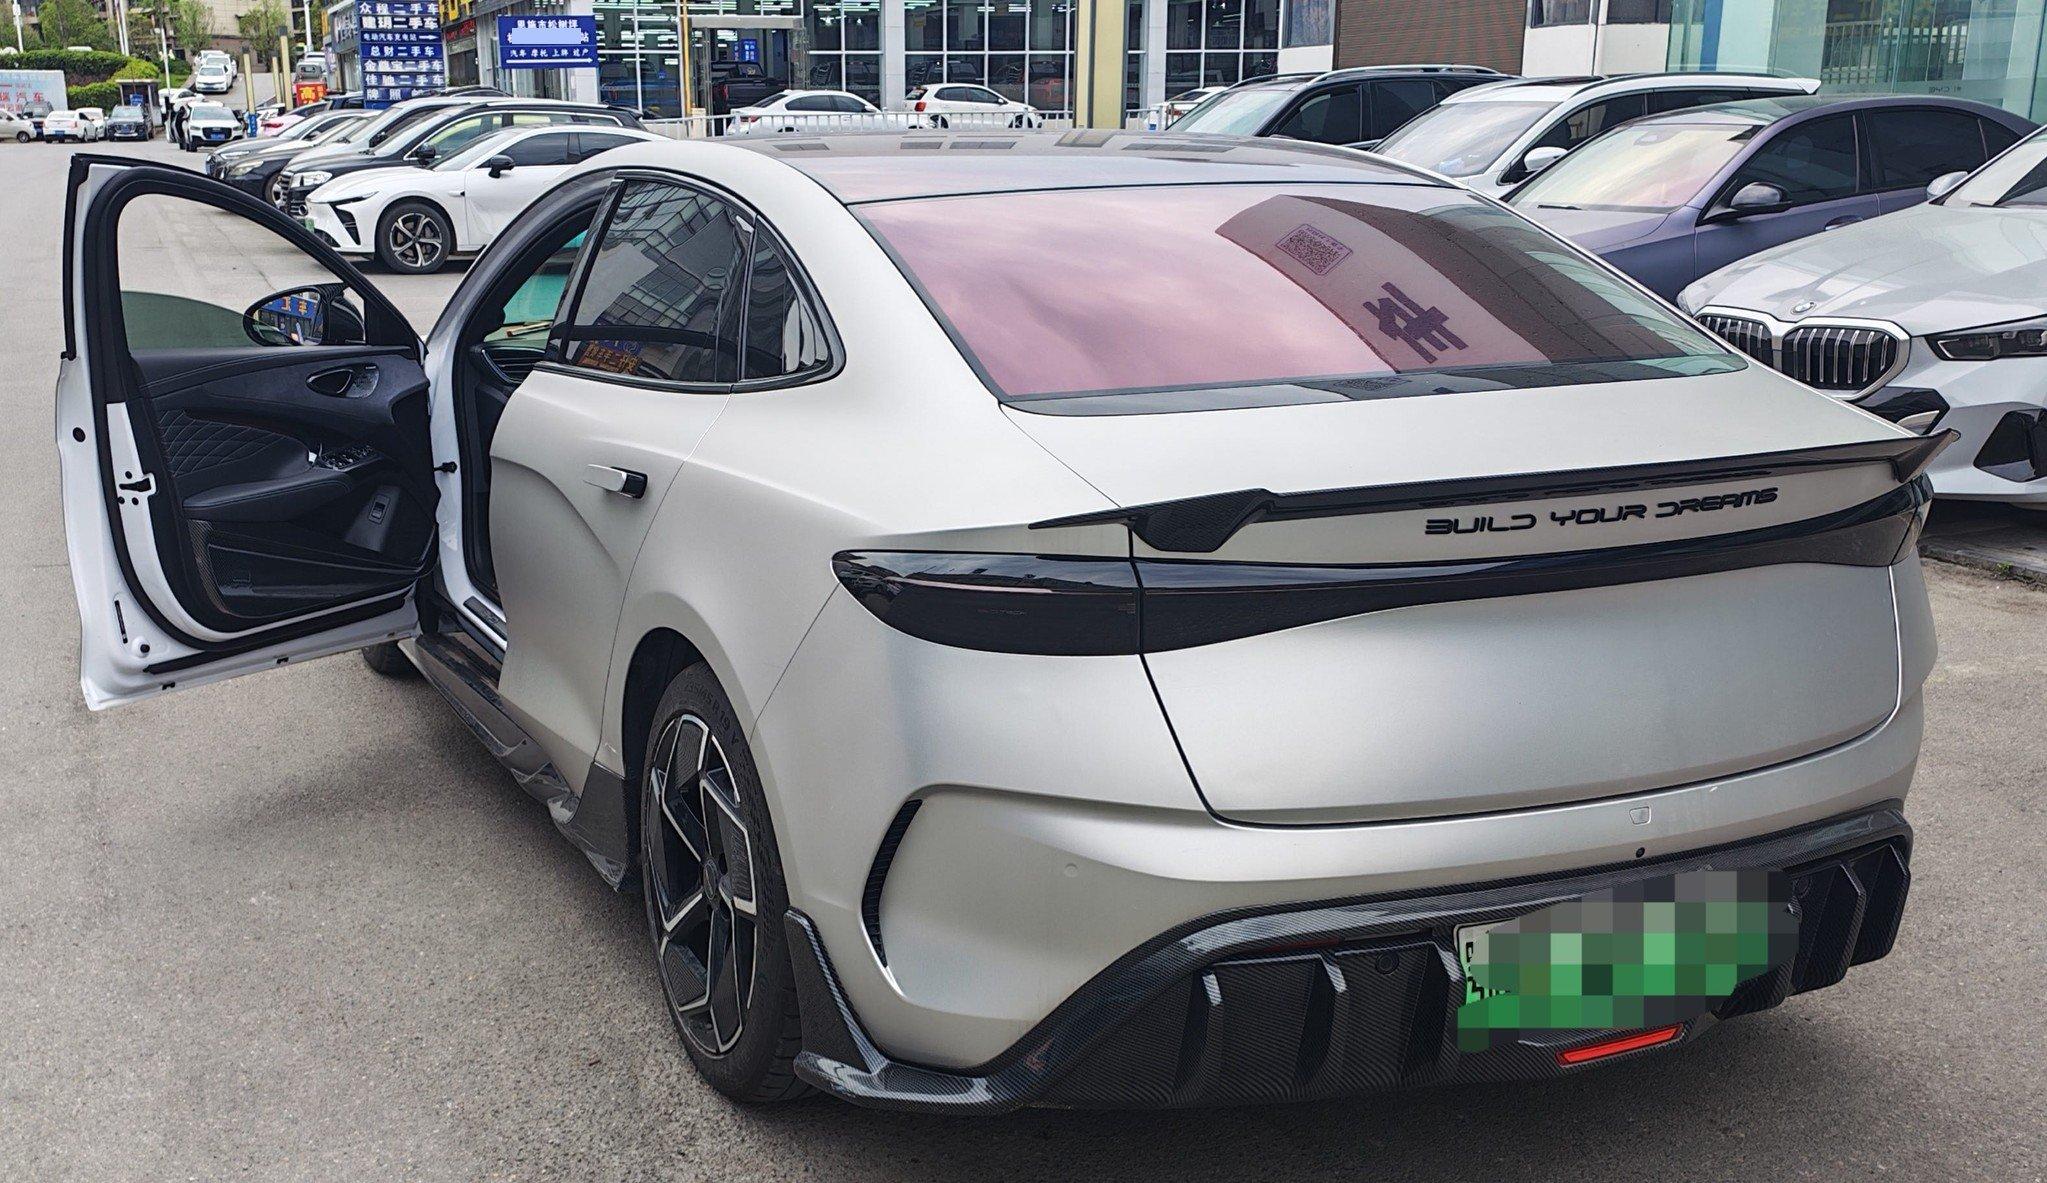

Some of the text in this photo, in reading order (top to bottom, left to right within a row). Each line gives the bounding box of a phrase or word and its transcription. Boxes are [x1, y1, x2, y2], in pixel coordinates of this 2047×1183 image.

[363, 33, 417, 41] 电动汽车充电站
[510, 48, 526, 57] 汽车
[1425, 487, 1779, 535] BUILD YOUR DREAMS
